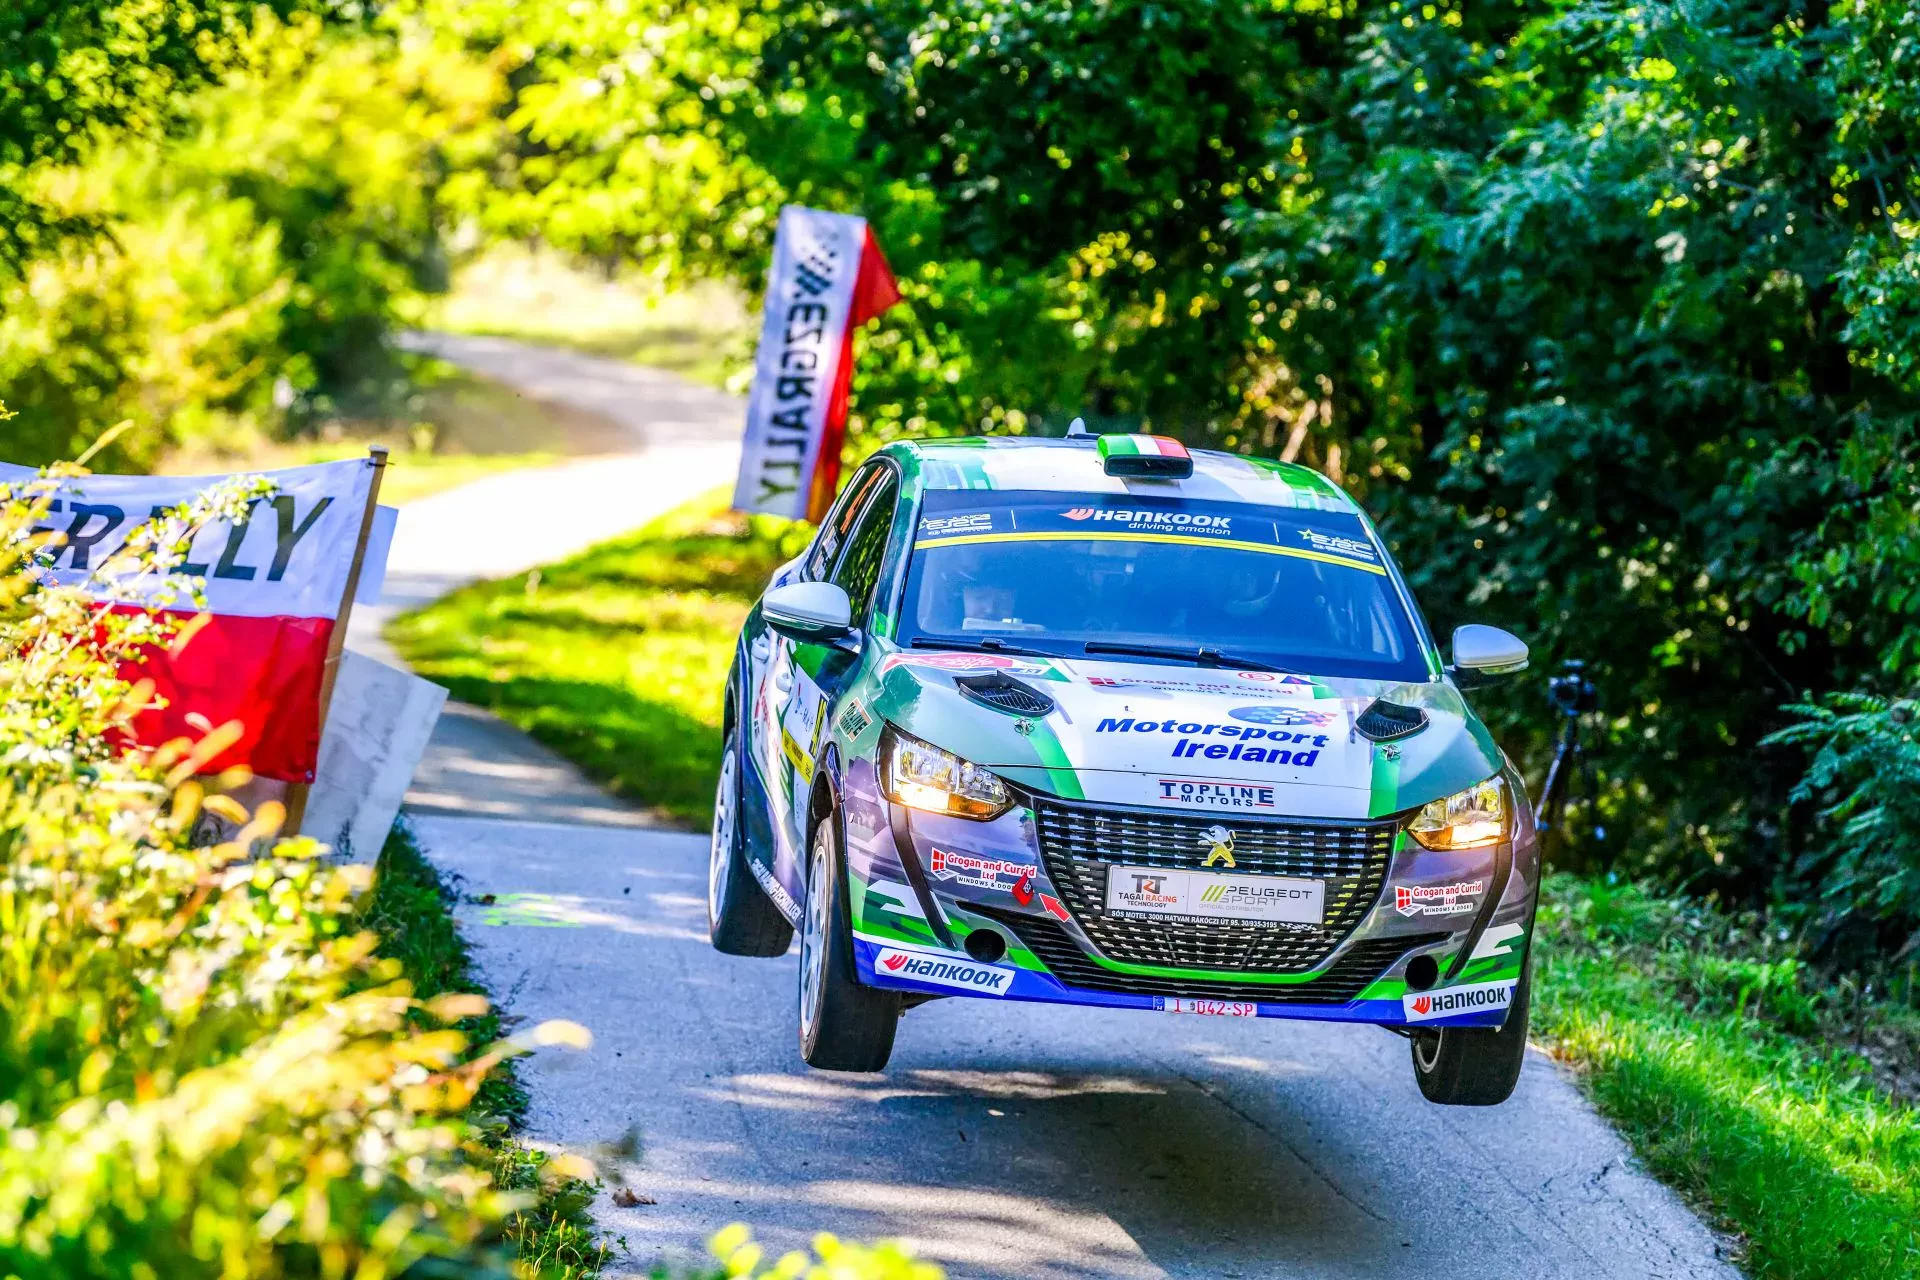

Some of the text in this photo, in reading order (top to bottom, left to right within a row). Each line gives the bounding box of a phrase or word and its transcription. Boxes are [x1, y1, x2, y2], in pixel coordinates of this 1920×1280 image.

[1128, 522, 1232, 536] driving emotion
[1095, 718, 1330, 748] Motorsport
[1171, 738, 1320, 767] Ireland
[1159, 782, 1274, 804] TOPLINE
[1180, 794, 1254, 807] MOTORS
[948, 854, 1035, 876] Grogan and Currid
[958, 876, 988, 886] WINDOWS
[982, 872, 994, 880] Ltd
[1226, 886, 1312, 900] PEUGEOT
[1414, 882, 1482, 898] Grogan and Currid
[1118, 892, 1178, 903] TAGAI RACING
[1219, 894, 1280, 906] SPORT
